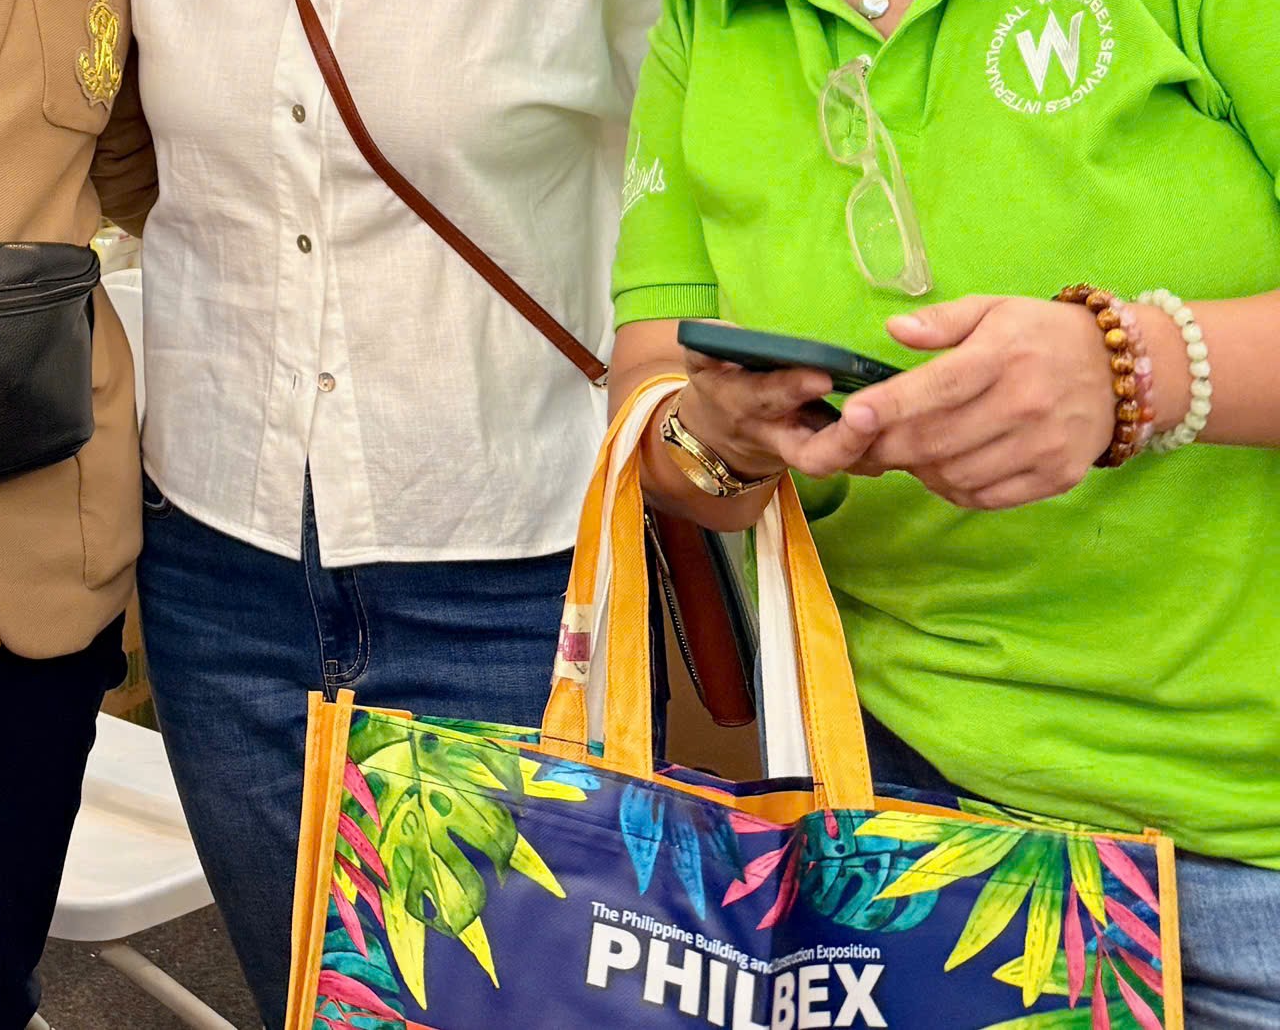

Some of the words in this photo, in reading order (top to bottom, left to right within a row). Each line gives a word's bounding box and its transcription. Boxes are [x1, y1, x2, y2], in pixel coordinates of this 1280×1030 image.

[985, 5, 1042, 114] INTERNATIONAL
[1045, 37, 1115, 113] SERVICES
[1016, 6, 1085, 95] W
[585, 921, 889, 1030] PHILBEX
[591, 901, 620, 922] The
[621, 909, 694, 946] Philippine
[695, 933, 749, 970] Building
[816, 942, 881, 961] Exposition
